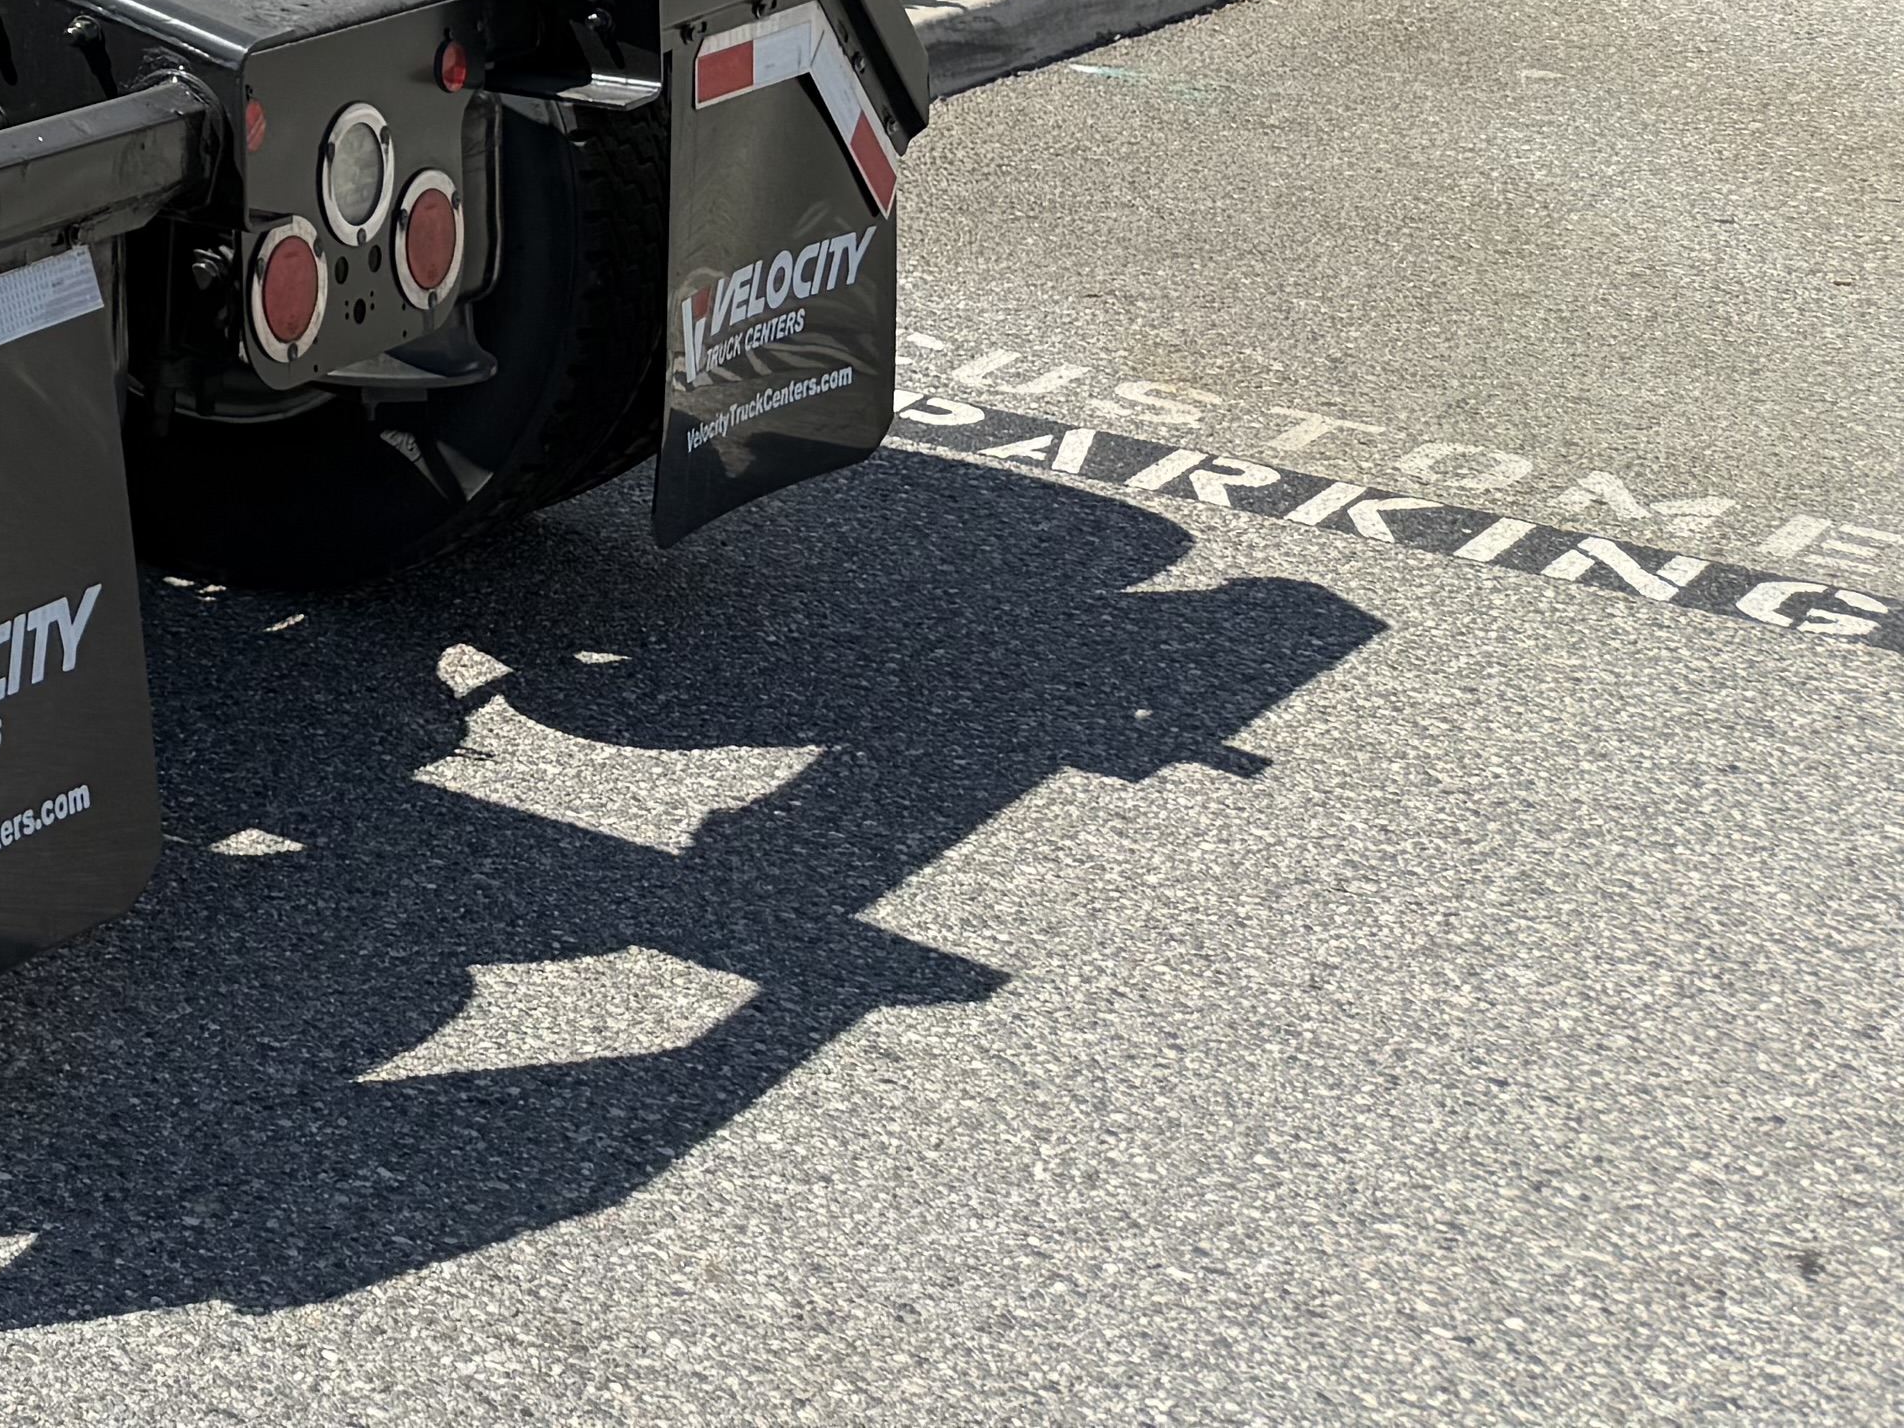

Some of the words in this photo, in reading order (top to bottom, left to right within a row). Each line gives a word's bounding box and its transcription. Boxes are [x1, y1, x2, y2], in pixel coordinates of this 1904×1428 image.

[710, 225, 877, 336] VELOCITY
[706, 334, 743, 372] TRUCK
[744, 307, 806, 351] CENTERS
[686, 365, 853, 453] VelocityTruckCenters.com
[893, 389, 1889, 636] PARKING
